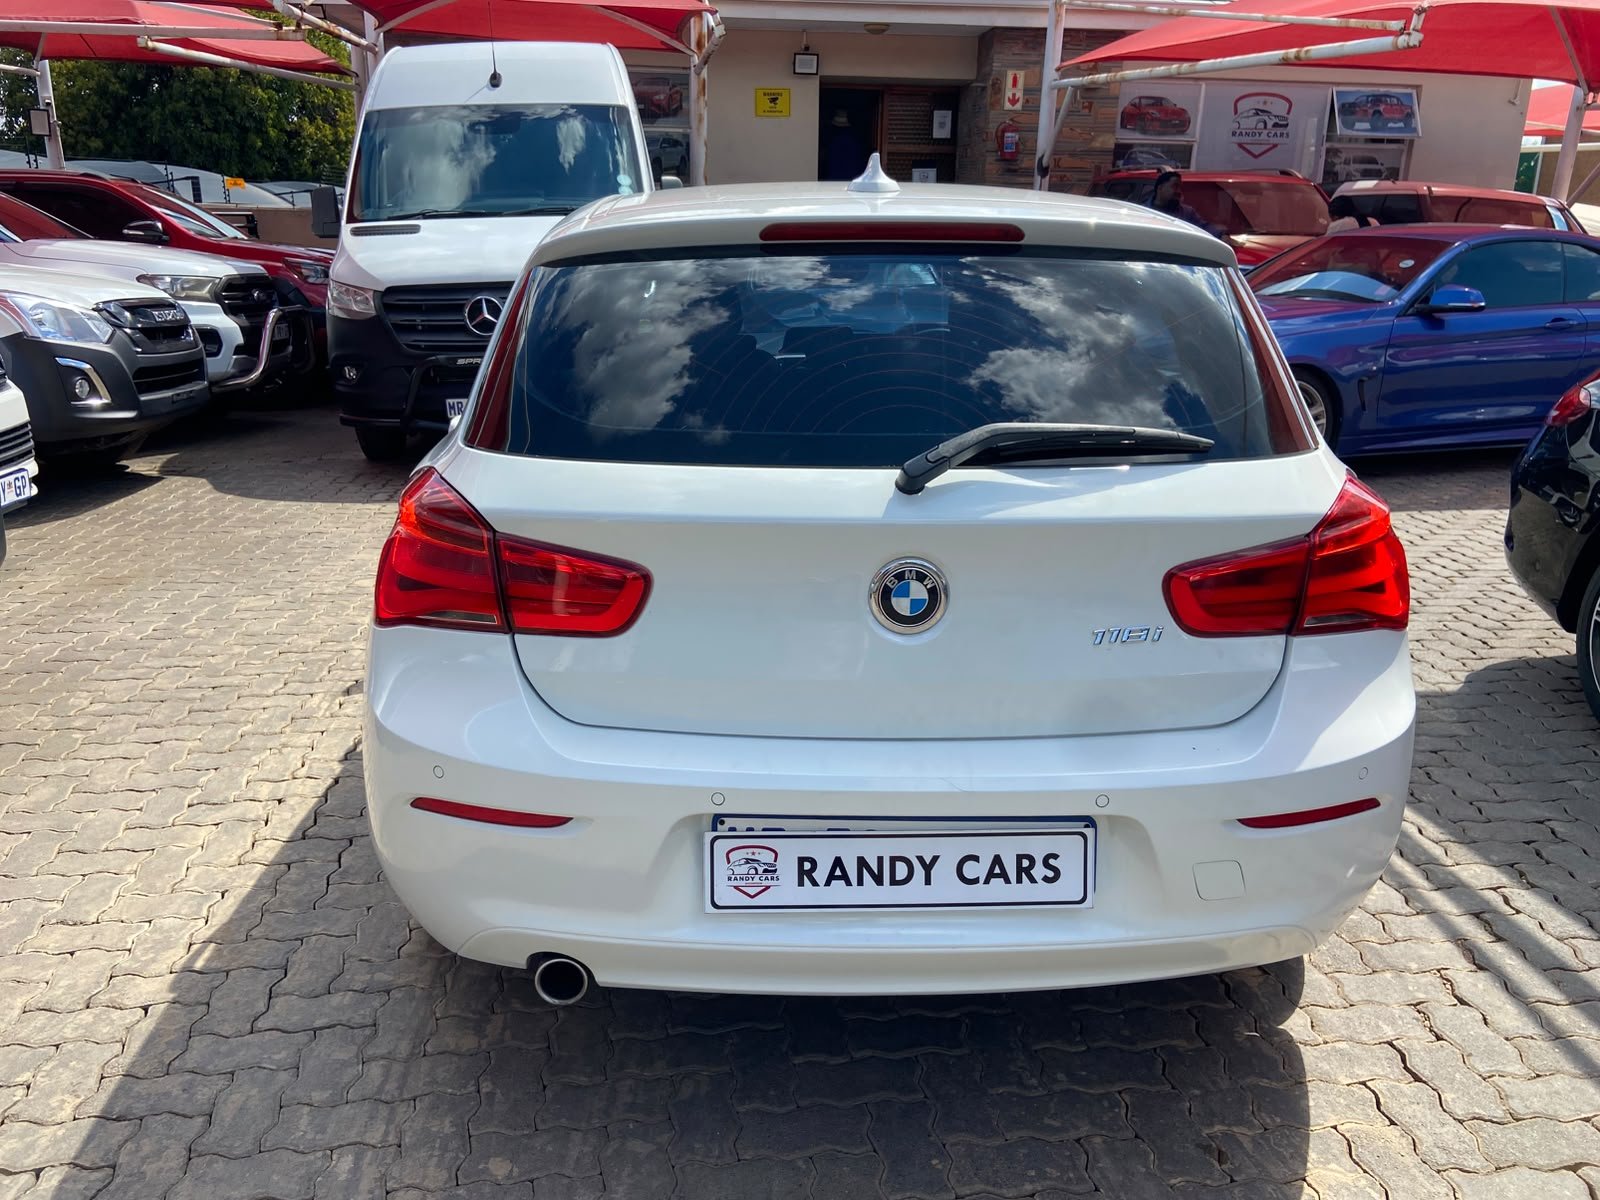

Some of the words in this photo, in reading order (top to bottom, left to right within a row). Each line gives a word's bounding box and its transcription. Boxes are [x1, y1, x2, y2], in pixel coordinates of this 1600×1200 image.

[1231, 130, 1263, 138] RANDY
[1267, 131, 1290, 139] CARS
[13, 475, 27, 498] GP
[886, 569, 937, 590] BMW
[1093, 625, 1164, 645] 118i
[797, 854, 941, 887] RANDY
[956, 852, 1062, 885] CARS
